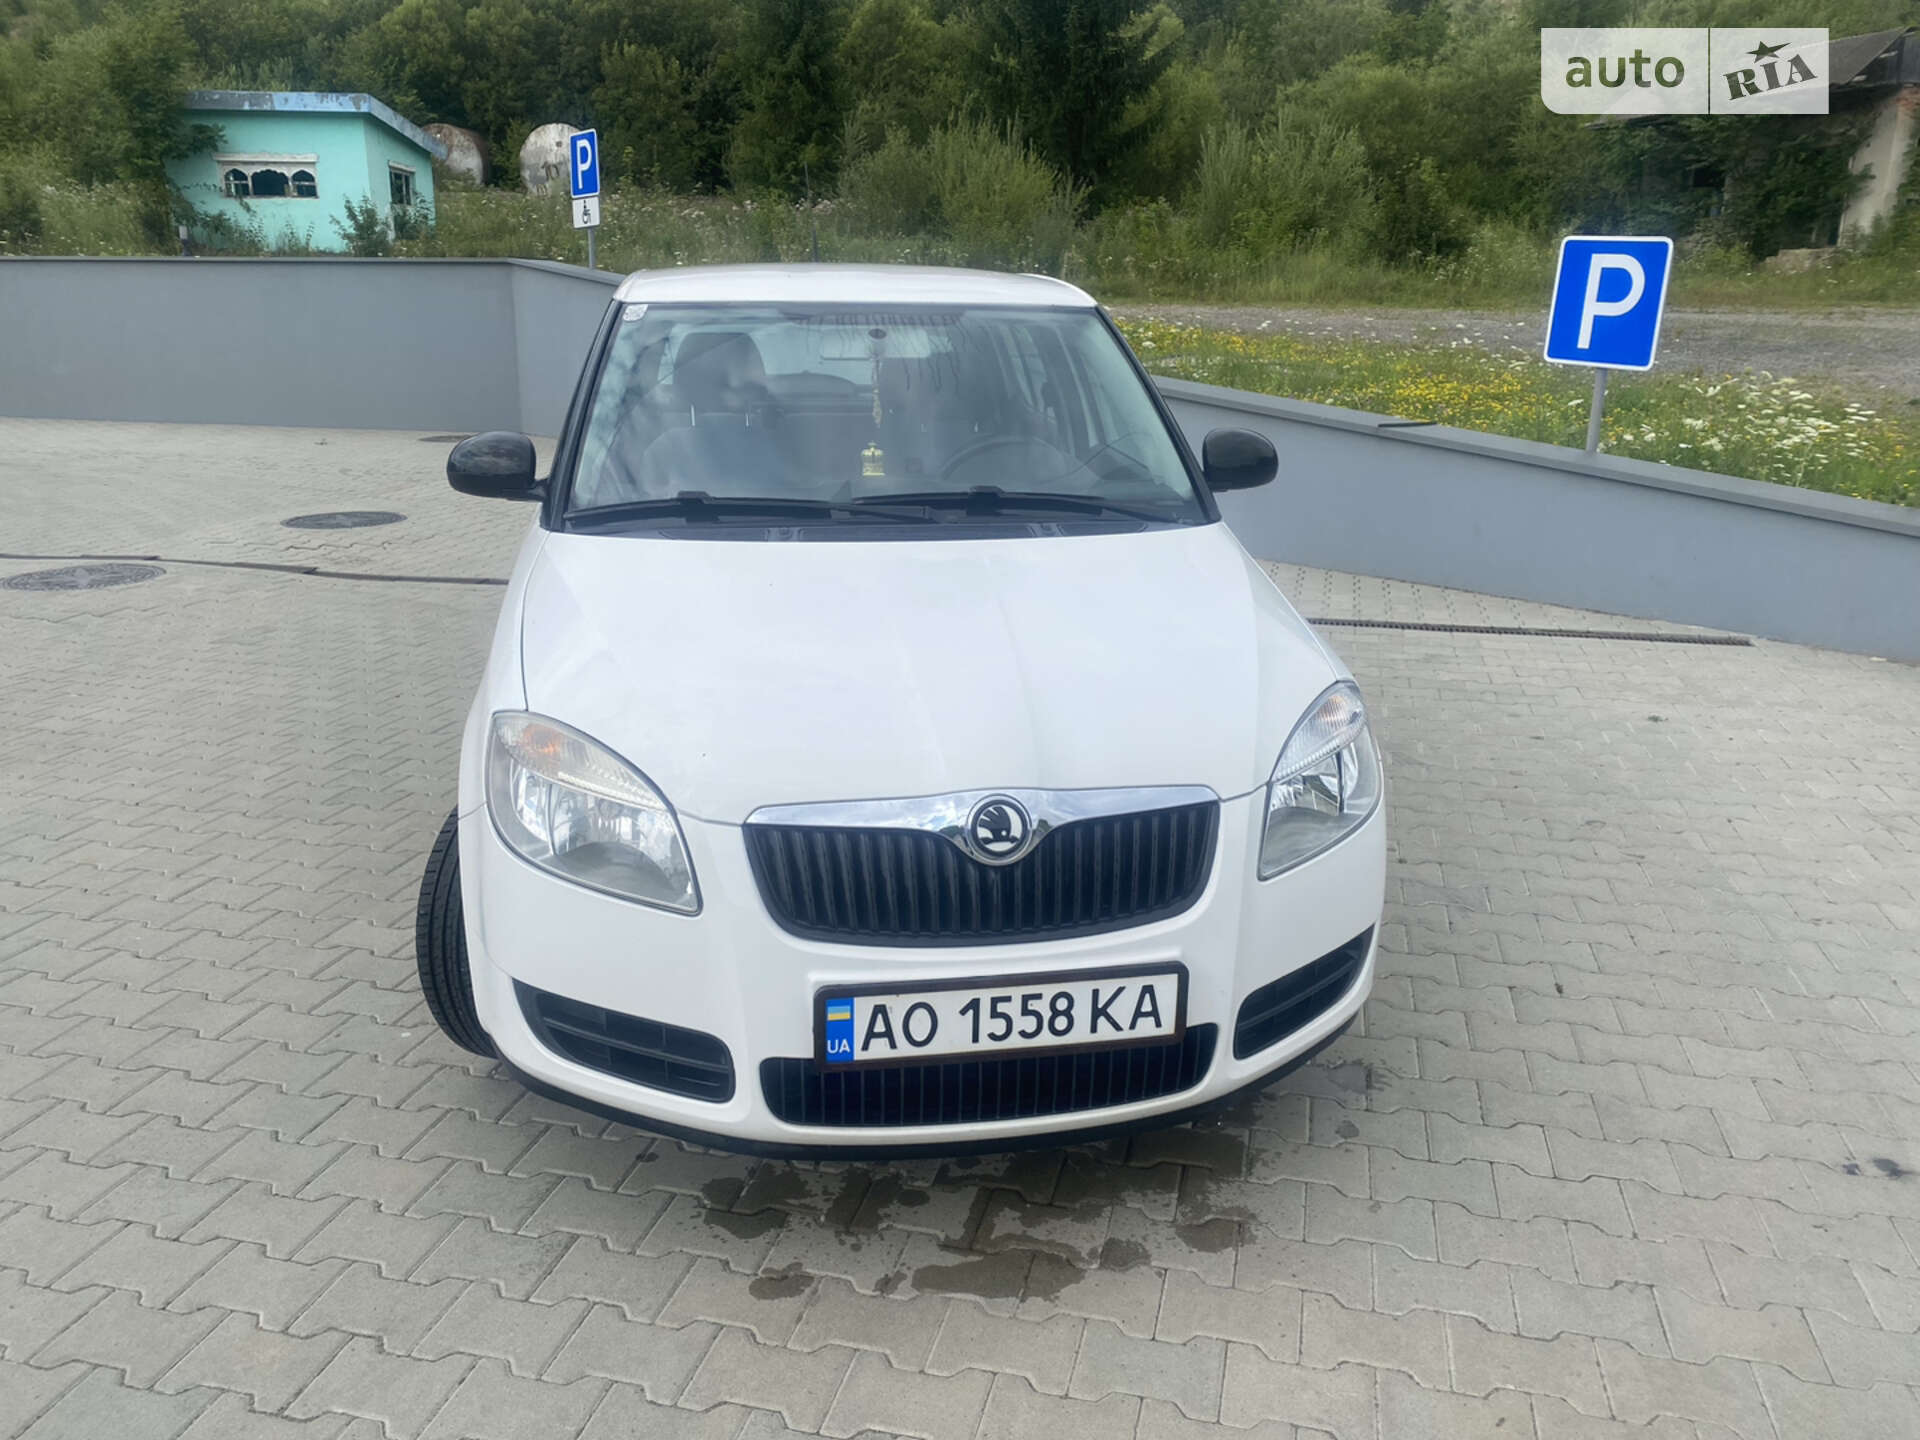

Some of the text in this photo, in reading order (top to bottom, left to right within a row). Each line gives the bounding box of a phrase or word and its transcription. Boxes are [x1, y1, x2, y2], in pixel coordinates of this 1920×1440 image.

[577, 139, 592, 190] P
[1577, 253, 1646, 349] P
[826, 1038, 851, 1054] UA
[861, 984, 1163, 1051] AO 1558 KA
